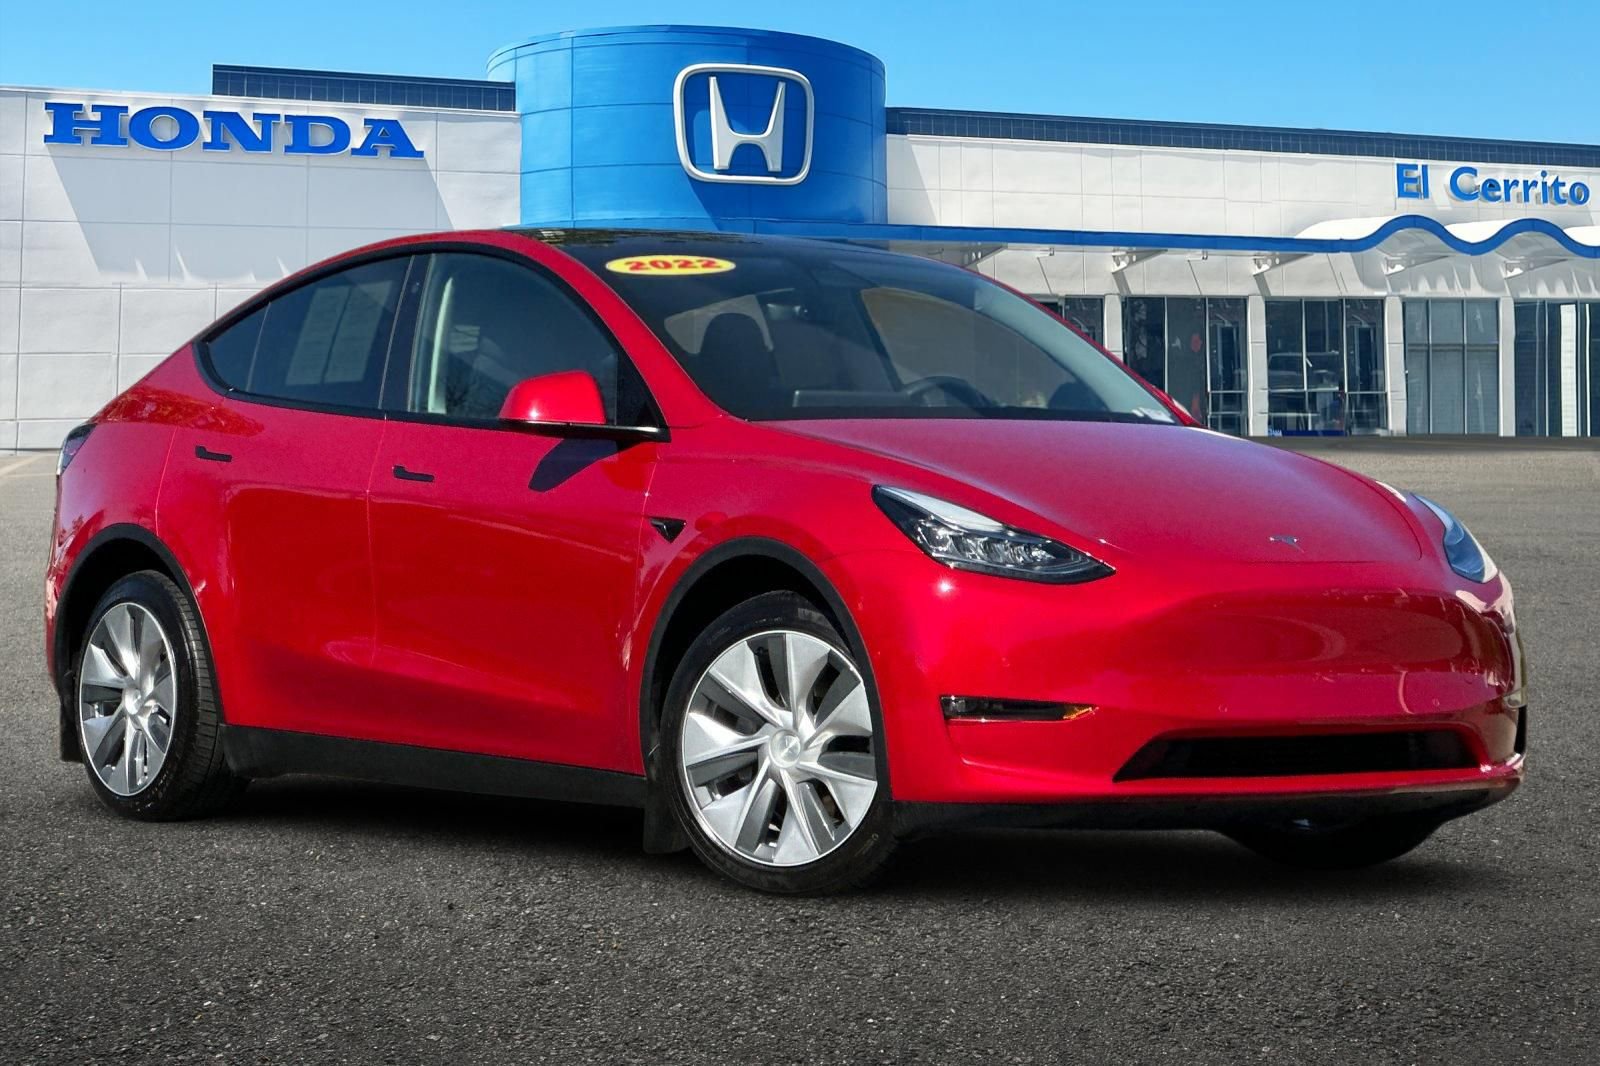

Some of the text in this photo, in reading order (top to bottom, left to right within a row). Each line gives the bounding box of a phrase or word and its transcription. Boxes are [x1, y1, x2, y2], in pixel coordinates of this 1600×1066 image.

[44, 102, 425, 158] HONDA
[1395, 162, 1590, 205] El Cerrito
[624, 259, 722, 271] 2022
